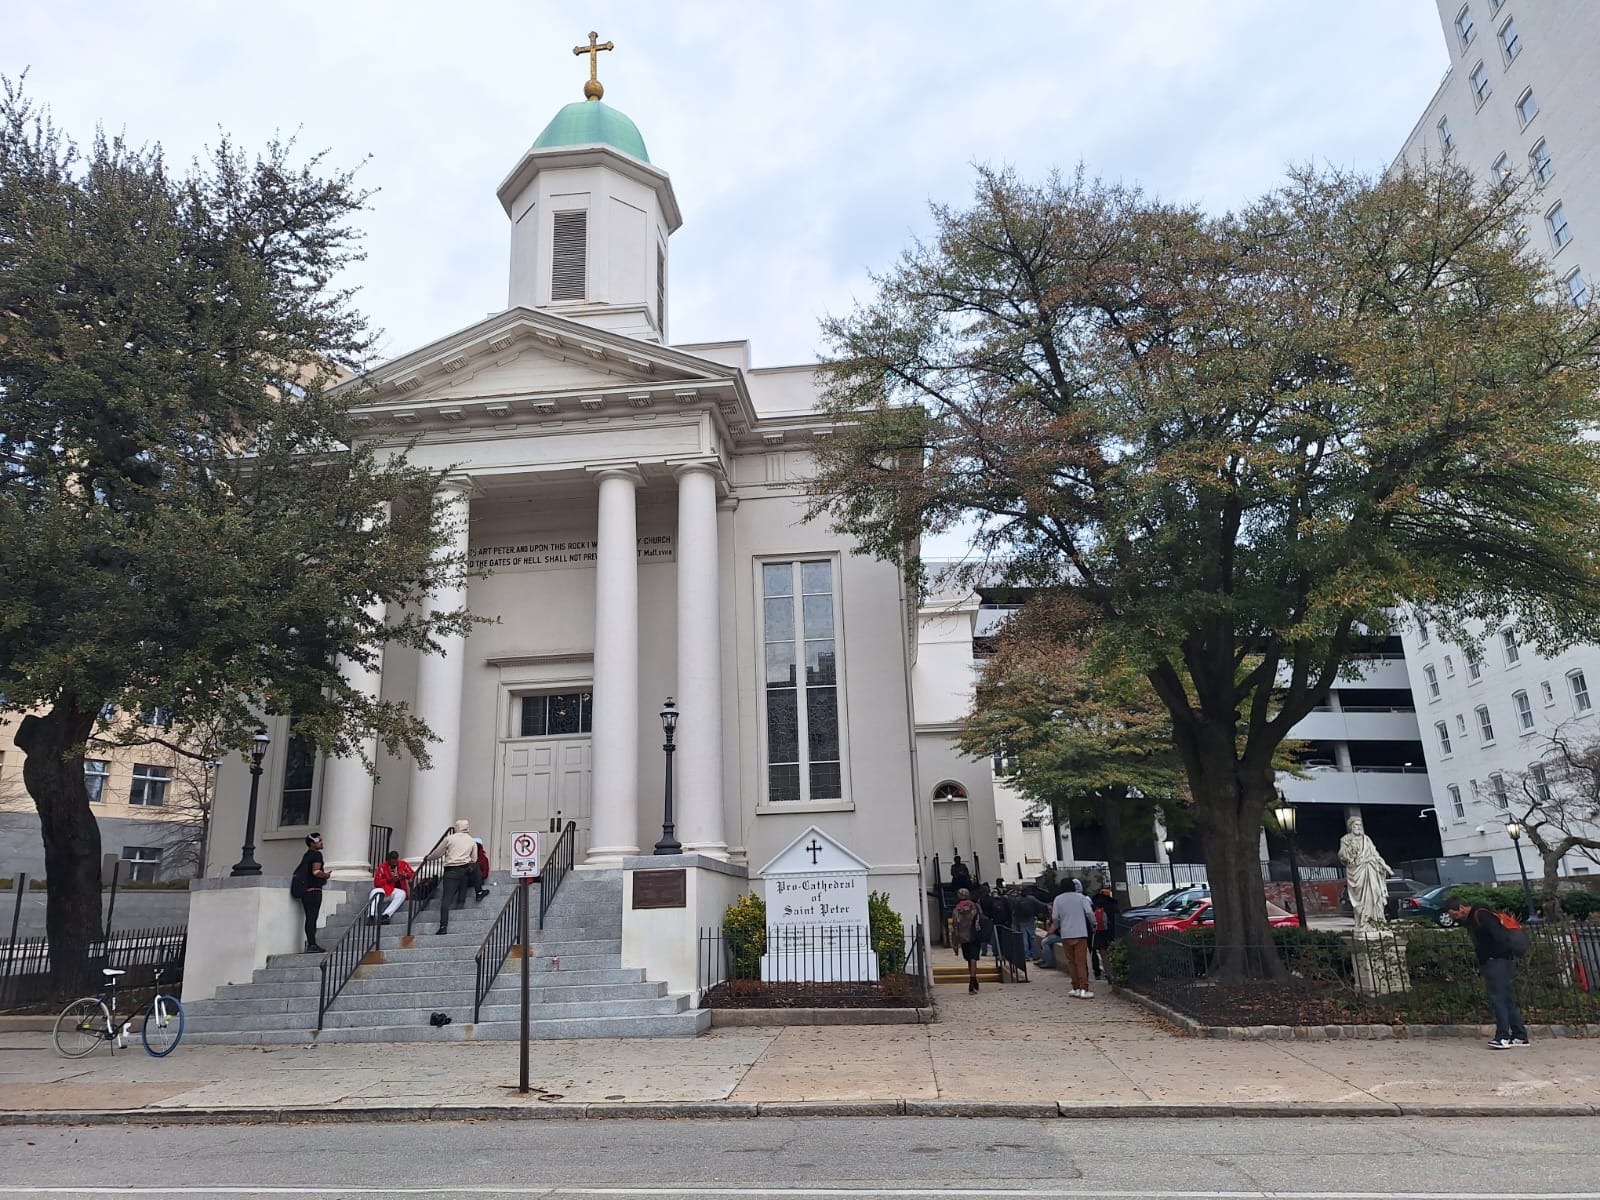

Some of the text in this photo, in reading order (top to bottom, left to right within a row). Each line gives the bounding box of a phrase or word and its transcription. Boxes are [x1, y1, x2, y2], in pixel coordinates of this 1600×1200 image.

[478, 547, 493, 555] ART
[529, 544, 549, 553] UPON
[550, 542, 566, 551] THIS
[567, 541, 586, 550] ROCK
[644, 536, 671, 544] CHURCH
[475, 560, 488, 568] THE
[489, 558, 511, 567] GATES
[512, 557, 522, 565] OF
[523, 556, 542, 565] HELL
[544, 555, 568, 563] SHALL
[569, 554, 582, 562] NOT
[776, 879, 855, 894] Pro-Cathedral
[811, 892, 822, 902] of
[783, 903, 851, 917] Saint Peter
